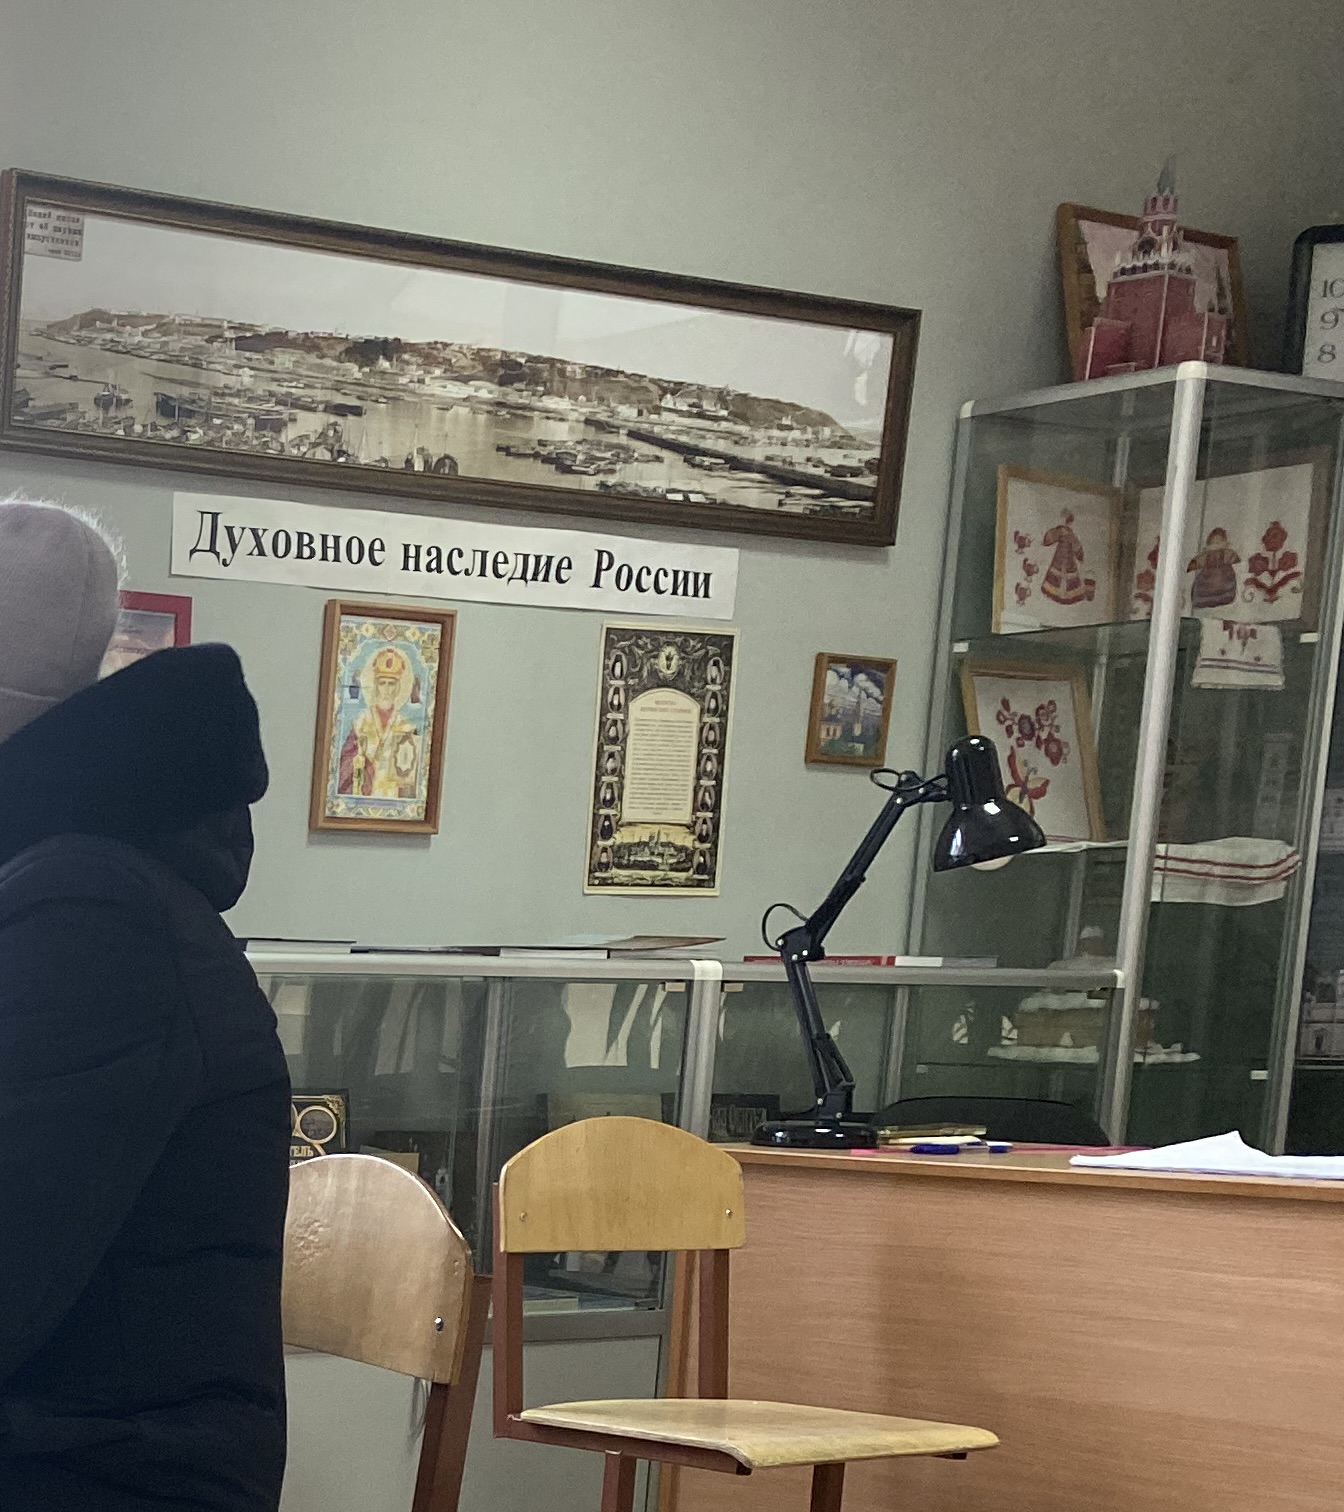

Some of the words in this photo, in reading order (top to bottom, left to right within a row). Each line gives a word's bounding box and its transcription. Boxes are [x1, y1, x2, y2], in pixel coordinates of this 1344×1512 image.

[1318, 344, 1336, 363] 8
[188, 510, 387, 567] Духовное
[401, 541, 574, 585] наследие
[590, 548, 714, 600] России
